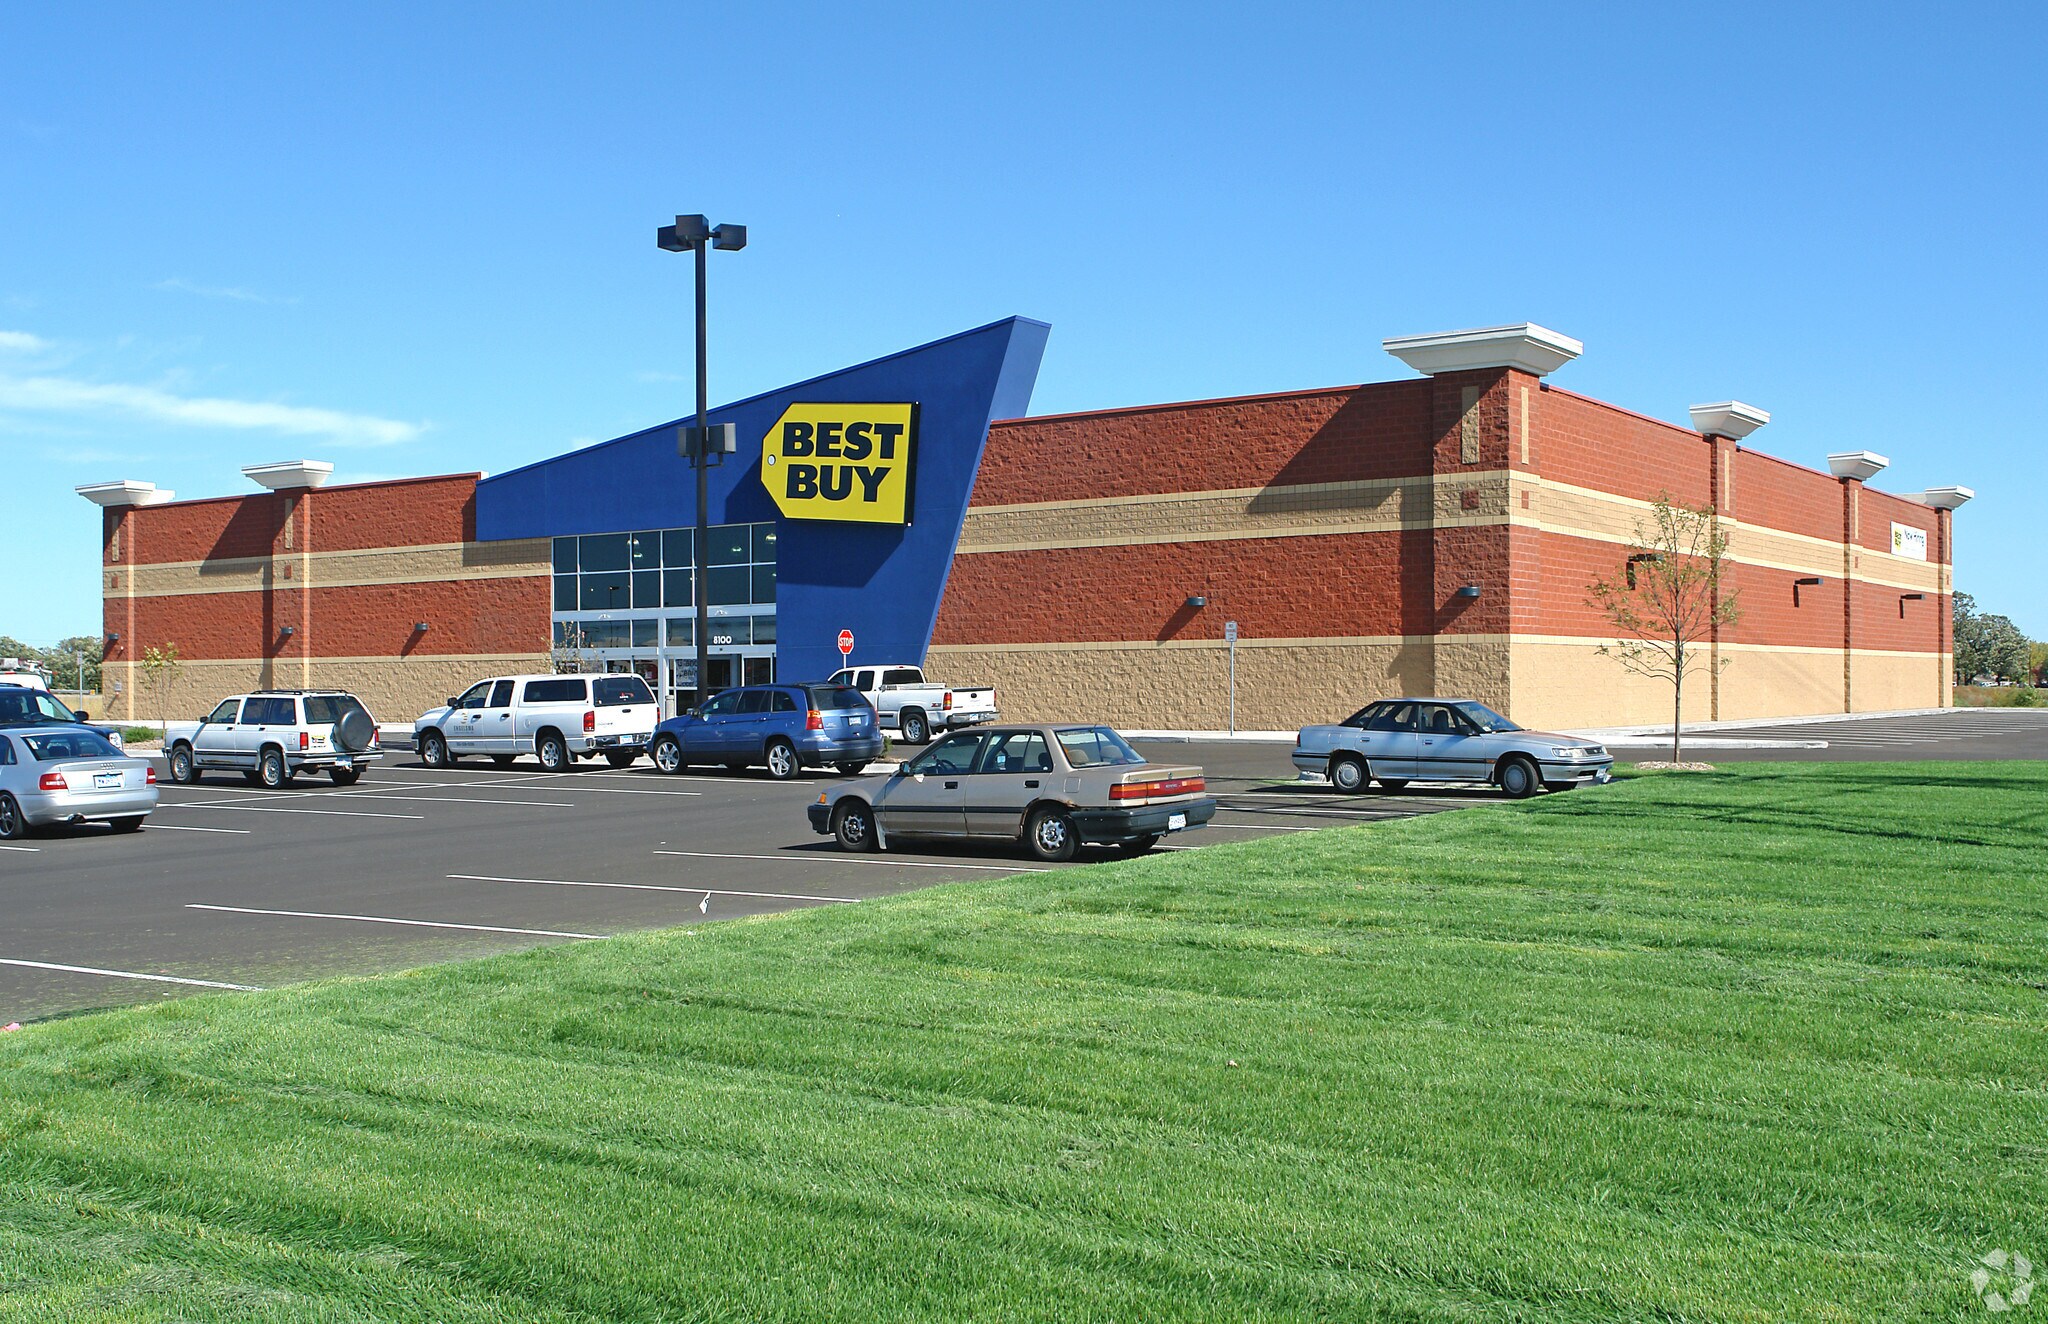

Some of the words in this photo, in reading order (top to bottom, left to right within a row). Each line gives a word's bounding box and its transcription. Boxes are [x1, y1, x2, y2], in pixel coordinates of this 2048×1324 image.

[782, 422, 904, 461] BEST
[786, 464, 892, 502] BUY
[713, 635, 732, 645] 8100
[838, 637, 853, 647] STOP
